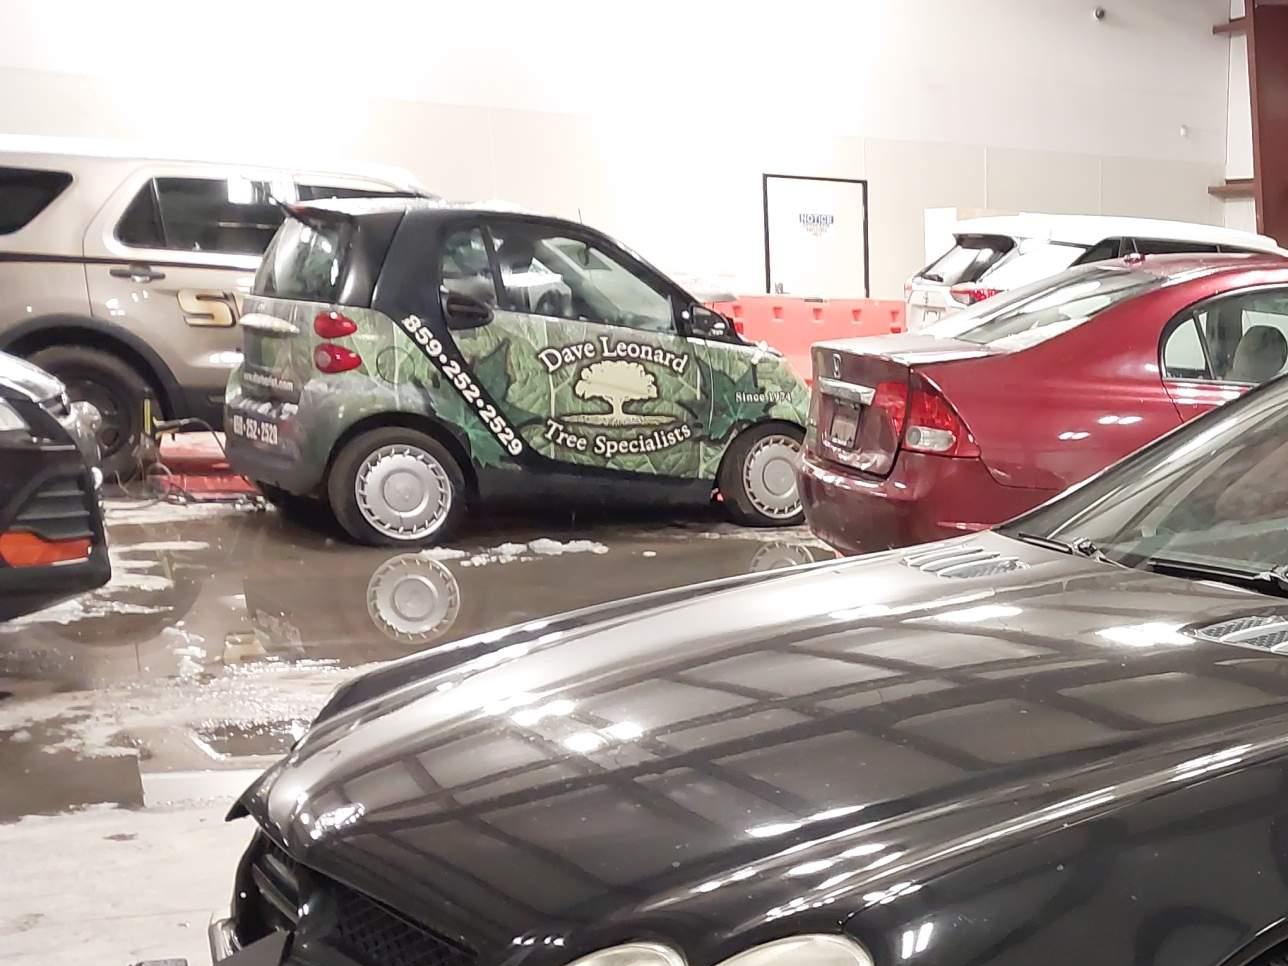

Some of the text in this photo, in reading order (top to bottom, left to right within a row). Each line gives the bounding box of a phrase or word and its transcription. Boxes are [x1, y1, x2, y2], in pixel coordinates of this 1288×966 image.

[538, 336, 689, 374] Dave Leonard
[735, 390, 766, 404] Since
[544, 419, 692, 458] Tree Specialists
